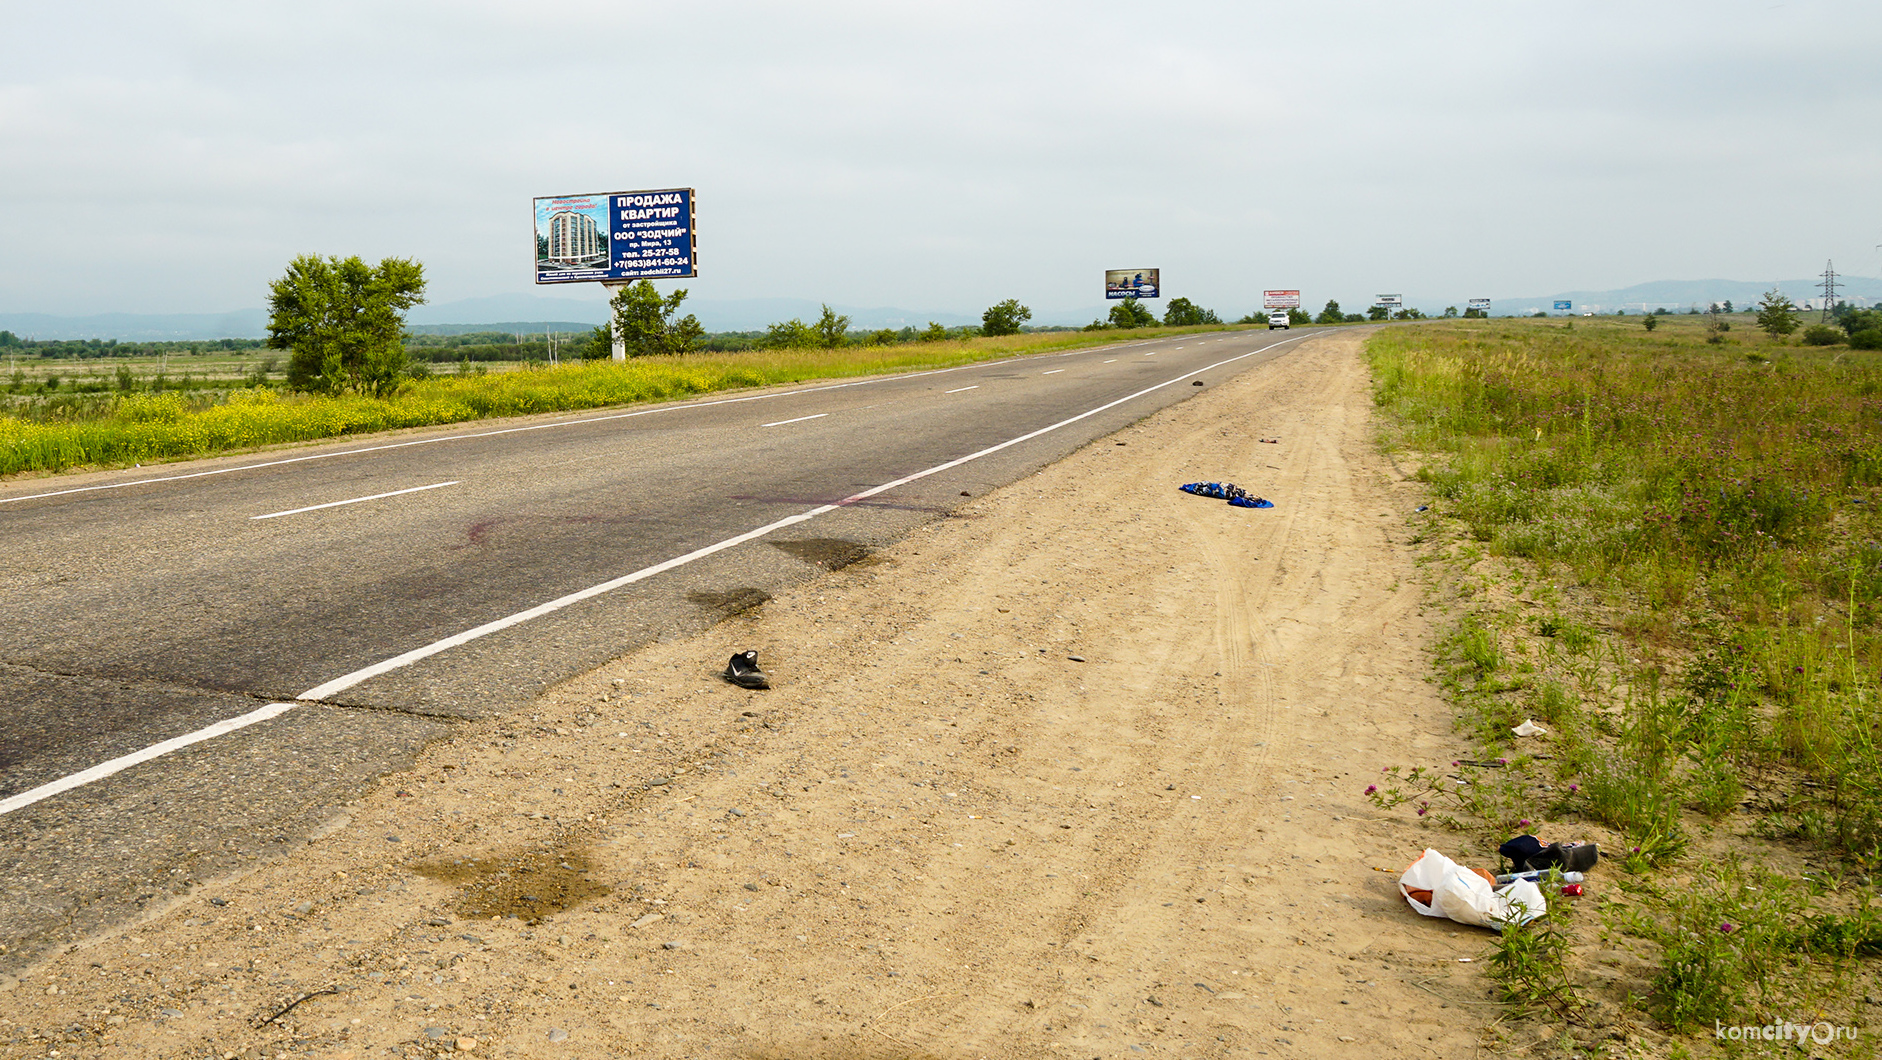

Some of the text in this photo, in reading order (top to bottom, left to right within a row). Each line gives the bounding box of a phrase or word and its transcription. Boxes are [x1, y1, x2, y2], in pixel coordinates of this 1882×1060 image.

[617, 193, 683, 208] ПРОДАЖА
[620, 207, 679, 221] КВАРТИР
[631, 220, 677, 229] застройщика
[614, 231, 635, 240] ООО
[641, 248, 680, 258] 25-27-58
[613, 257, 689, 269] +7(963)841-60-24
[640, 268, 682, 276] zodchii27.ru
